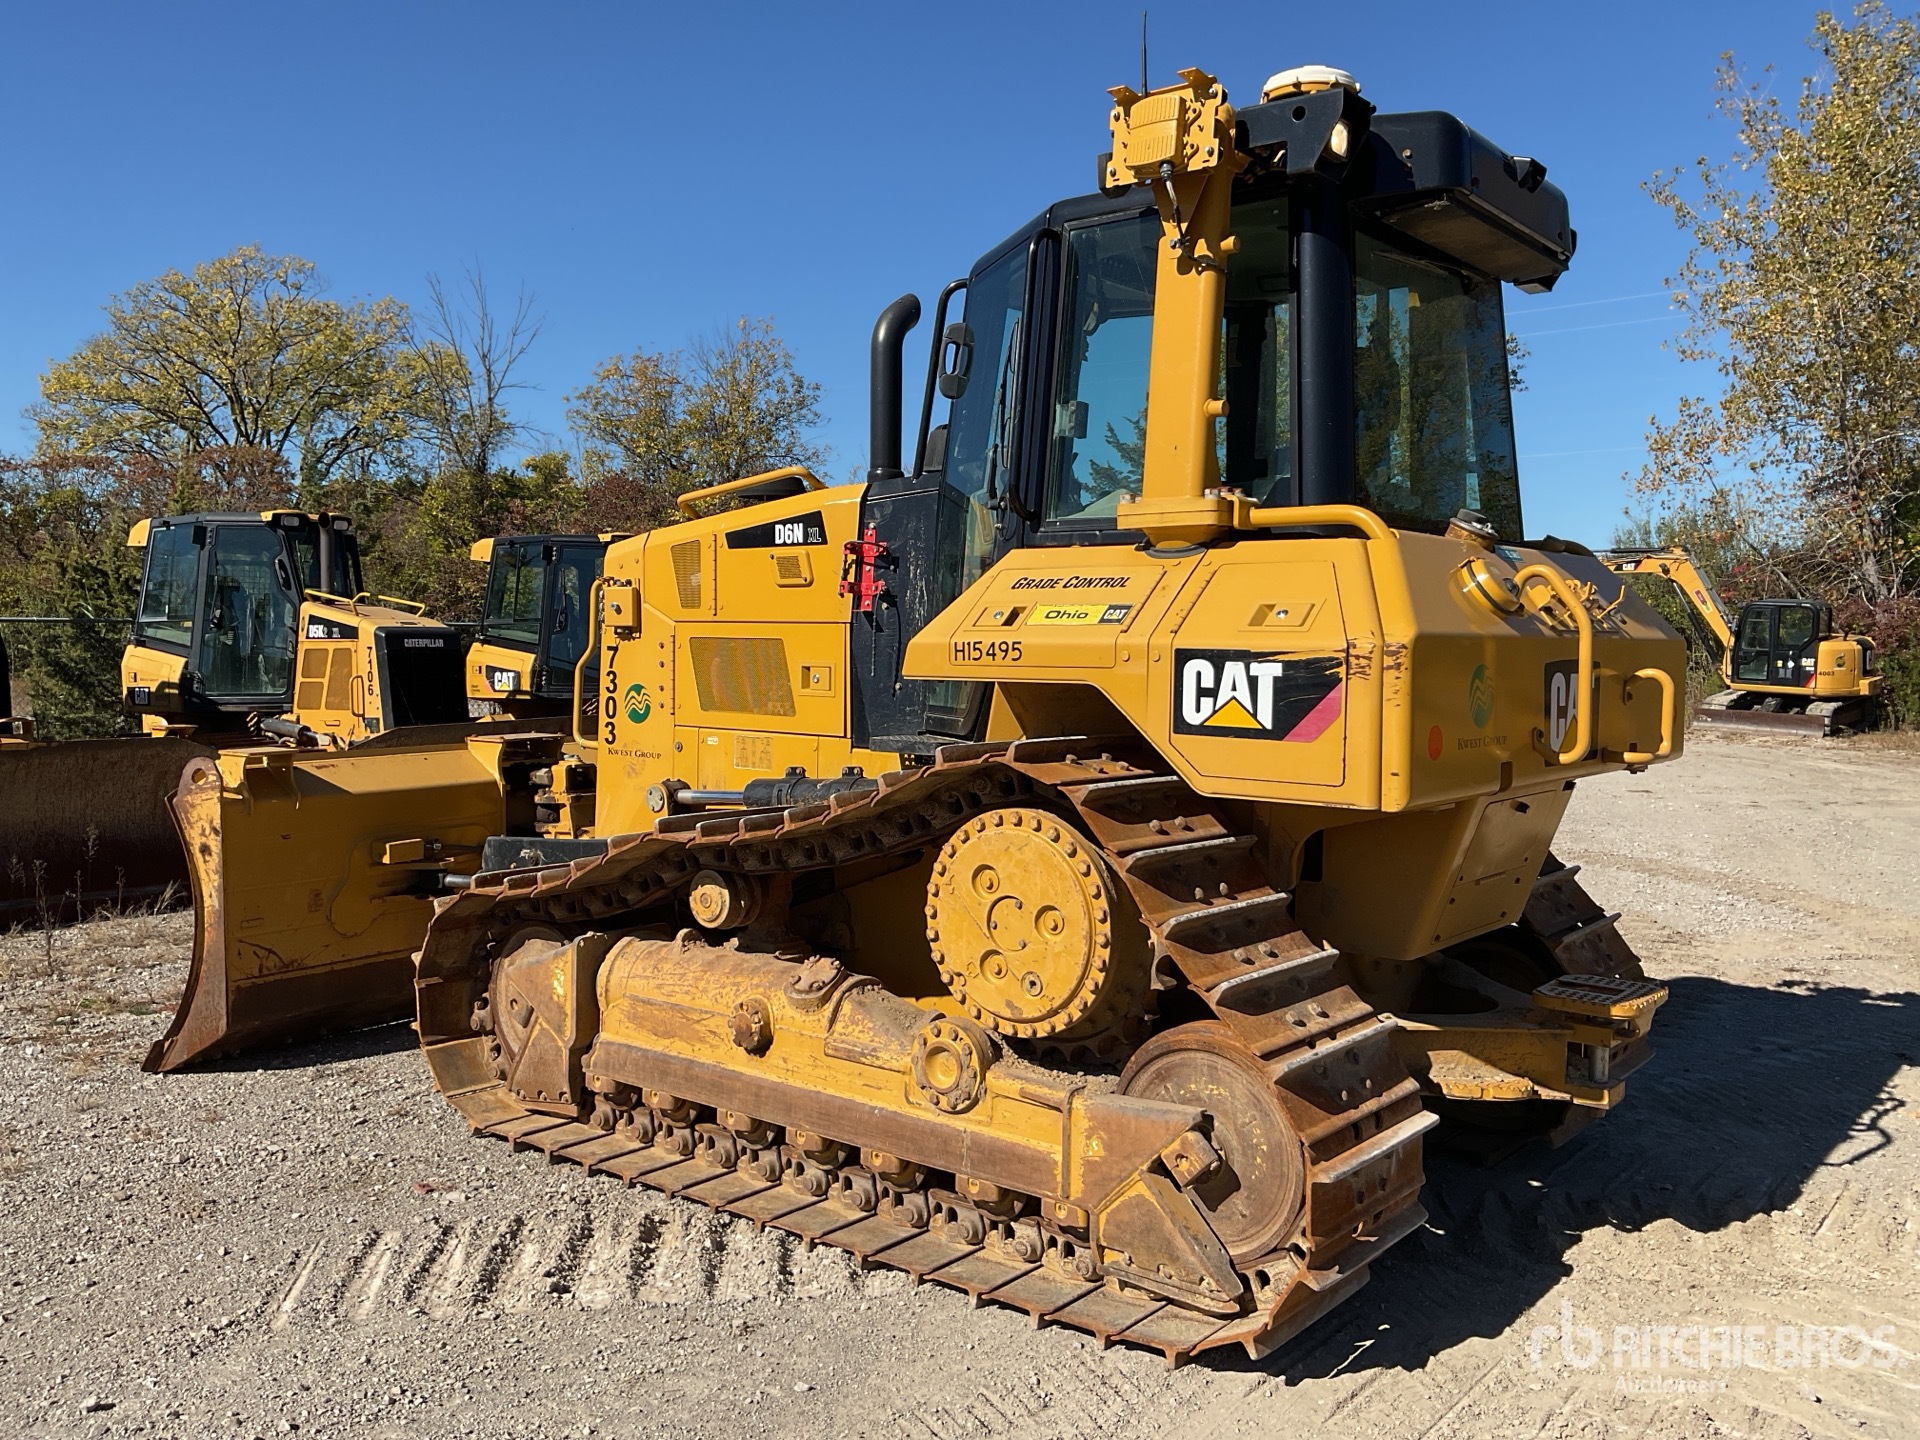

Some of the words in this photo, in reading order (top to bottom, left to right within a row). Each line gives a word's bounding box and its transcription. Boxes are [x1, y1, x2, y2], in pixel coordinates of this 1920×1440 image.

[774, 523, 803, 544] D6N
[807, 527, 822, 543] XL
[1011, 577, 1063, 590] GRADE
[1062, 576, 1131, 589] CONTROL
[1044, 610, 1089, 620] Ohio
[1103, 609, 1129, 620] CAT
[404, 638, 444, 648] CATERPILLAR
[953, 640, 1023, 662] H15495
[366, 646, 374, 696] 7106
[494, 671, 515, 691] CAT
[134, 687, 149, 705] CAT
[604, 645, 619, 746] 7303
[1181, 658, 1283, 731] CAT
[607, 747, 633, 757] KWEST
[634, 749, 662, 759] GROUP
[1457, 737, 1483, 751] KWEST
